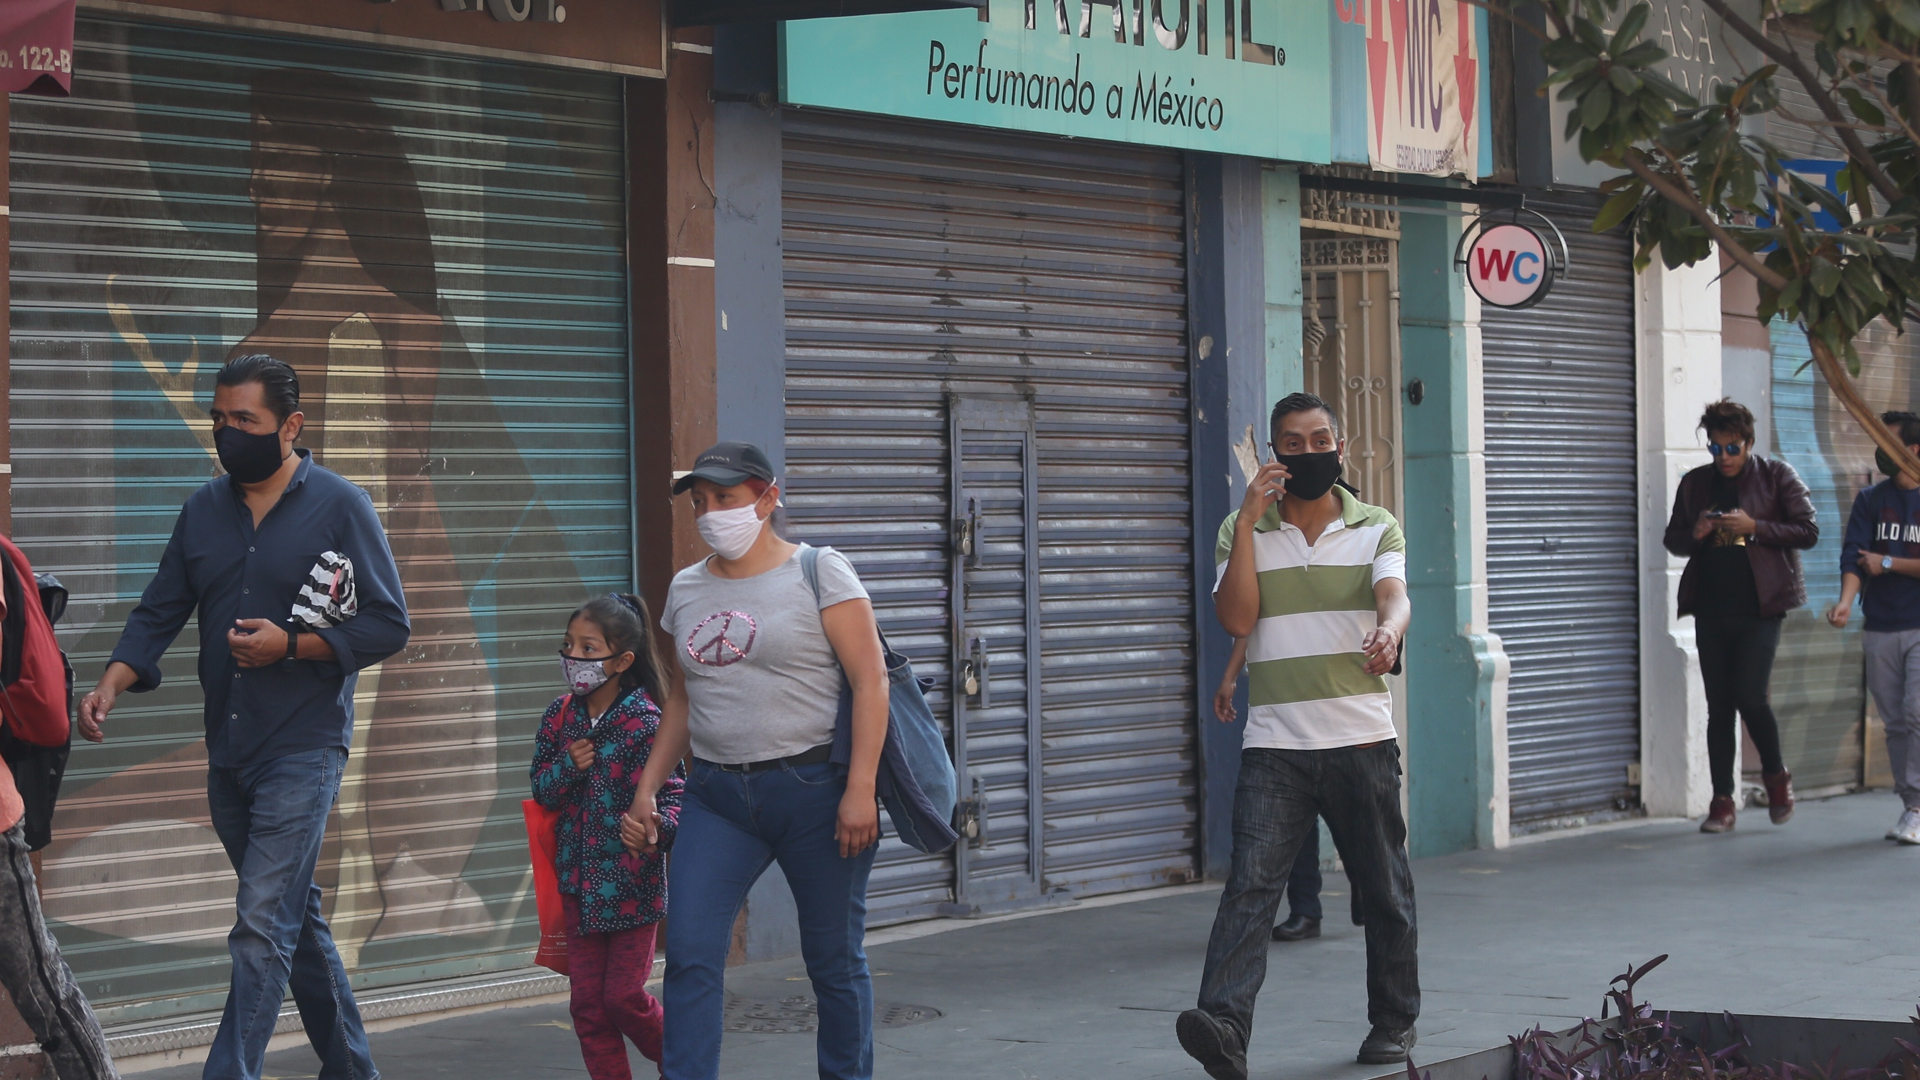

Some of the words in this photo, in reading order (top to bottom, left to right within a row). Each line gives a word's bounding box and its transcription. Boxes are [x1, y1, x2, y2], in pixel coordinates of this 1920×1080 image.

[19, 45, 72, 74] 122-B
[926, 38, 1096, 117] Perfumando
[1106, 84, 1123, 119] a
[1130, 68, 1225, 132] México
[1405, 0, 1443, 133] WC
[1477, 247, 1540, 285] WC
